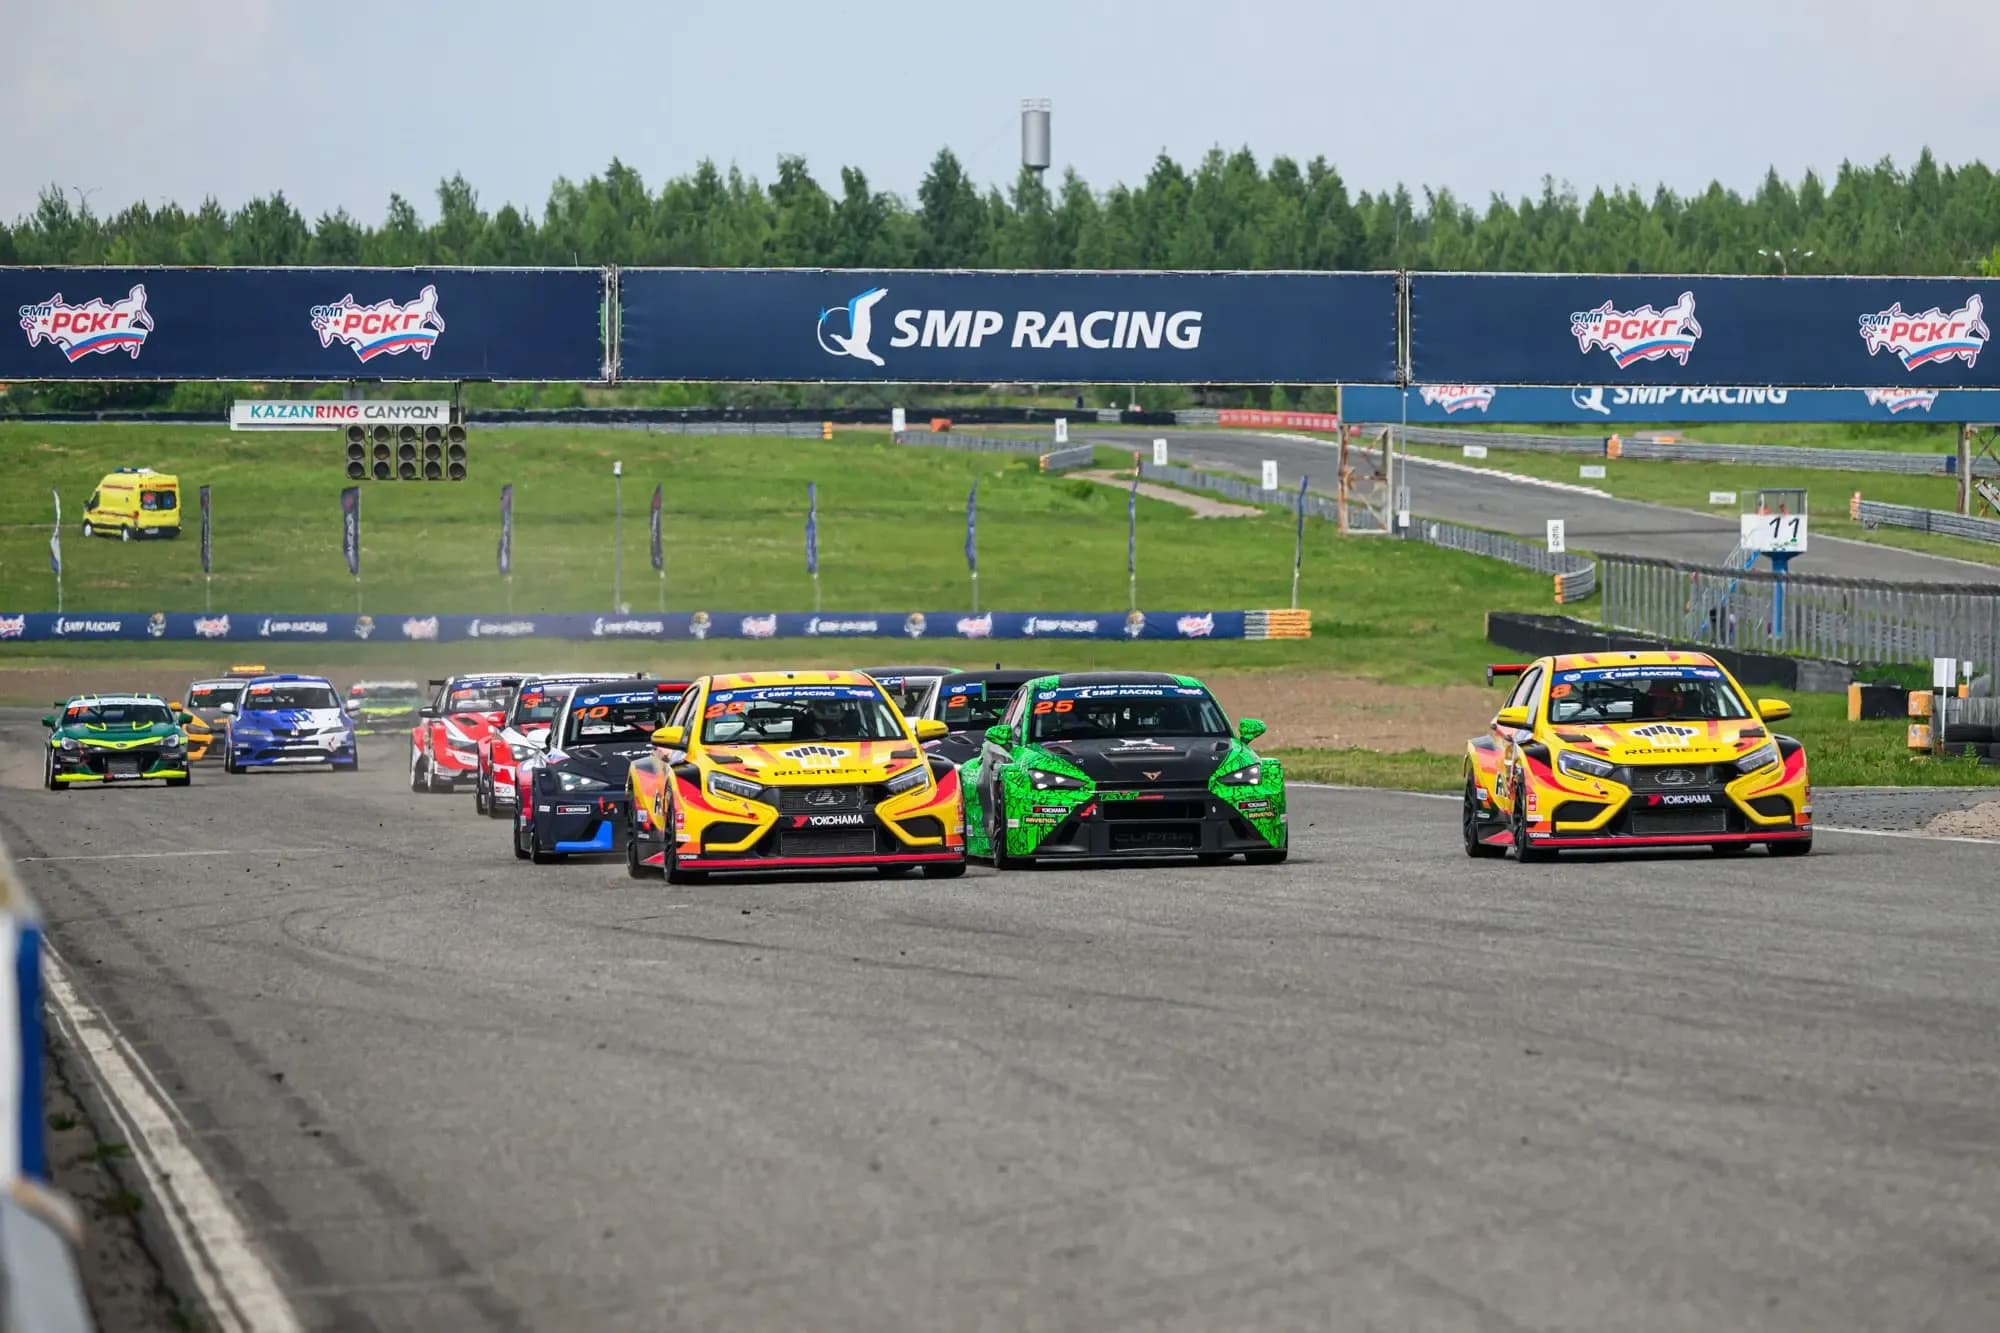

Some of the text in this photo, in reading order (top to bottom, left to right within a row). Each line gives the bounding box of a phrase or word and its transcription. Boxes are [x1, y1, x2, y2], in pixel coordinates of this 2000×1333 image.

[19, 305, 51, 316] СМП
[311, 306, 343, 317] СМП
[1571, 312, 1602, 323] СМП
[52, 312, 129, 334] РСКГ
[342, 313, 420, 334] РСКГ
[1860, 315, 1891, 326] СМП
[890, 309, 1203, 350] SMP RACING
[1602, 319, 1678, 340] РСКГ
[1890, 322, 1966, 343] РСКГ
[1613, 387, 1787, 404] SMP RACING
[251, 405, 360, 419] KAZANRING
[1769, 516, 1800, 539] 11
[948, 695, 968, 708] 2
[1034, 700, 1074, 714] 25
[572, 705, 609, 721] 10
[1662, 794, 1713, 804] YOKOHAMA
[809, 814, 865, 825] YOKOHAMA
